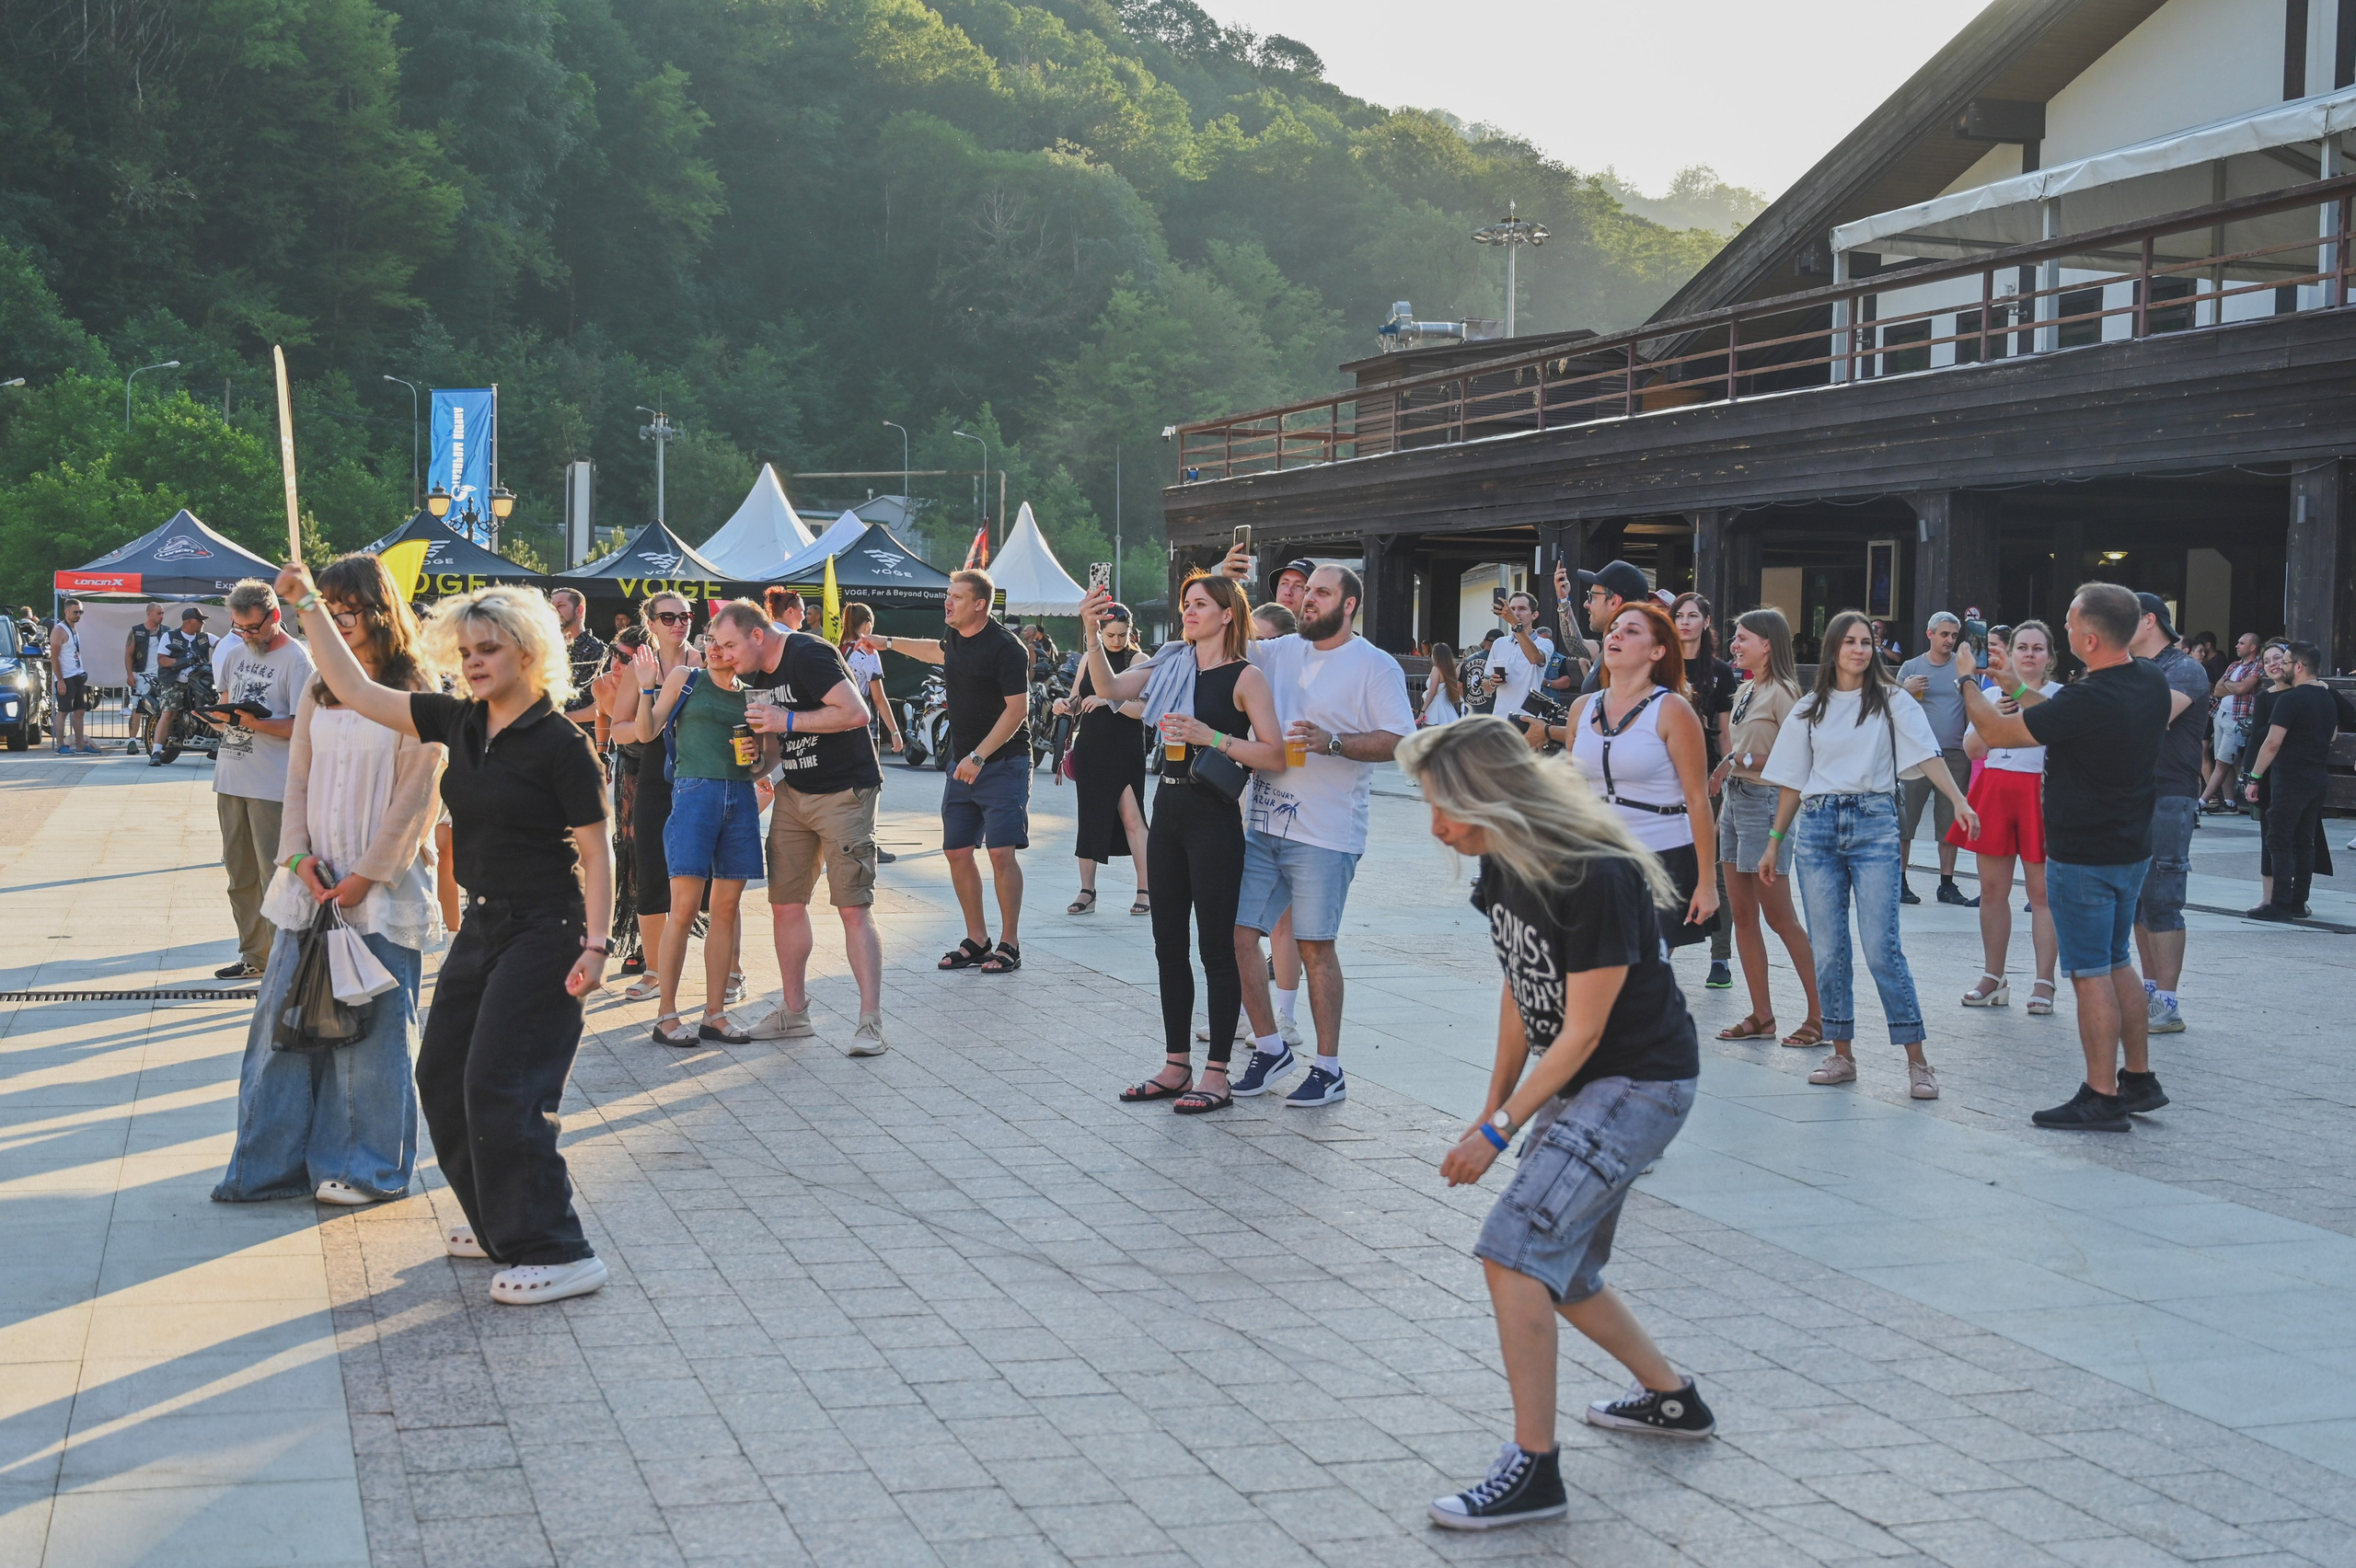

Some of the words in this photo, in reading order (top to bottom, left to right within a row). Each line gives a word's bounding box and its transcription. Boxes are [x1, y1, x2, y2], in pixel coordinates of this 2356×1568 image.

[422, 558, 454, 566] OGE
[872, 569, 913, 578] VOGE
[414, 572, 488, 595] OGE
[844, 589, 871, 597] VOGE,
[893, 589, 922, 598] Beyond
[798, 755, 818, 769] FIRE
[1272, 788, 1295, 801] COURT
[1491, 903, 1541, 965] SONS
